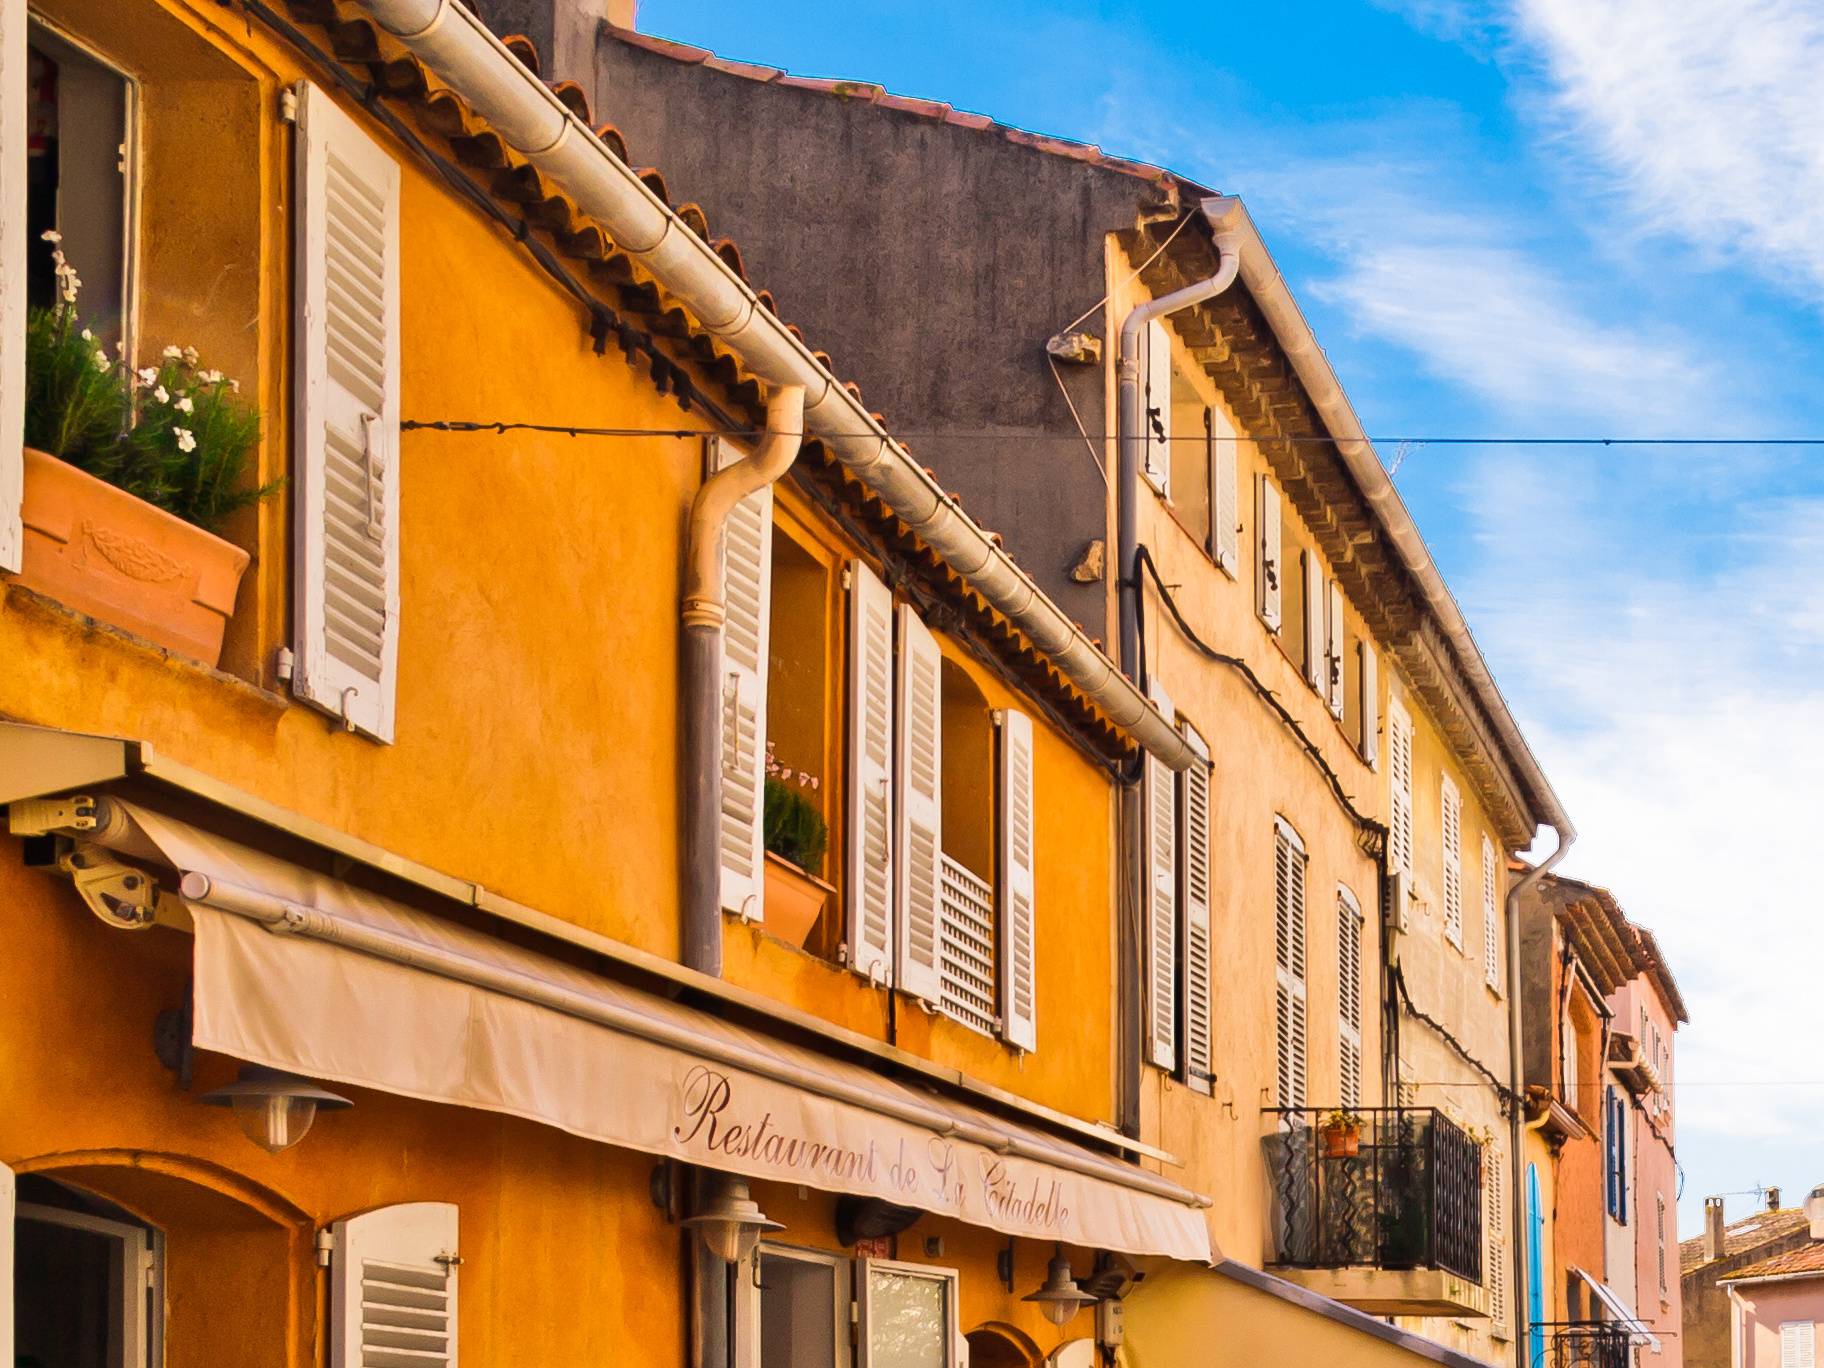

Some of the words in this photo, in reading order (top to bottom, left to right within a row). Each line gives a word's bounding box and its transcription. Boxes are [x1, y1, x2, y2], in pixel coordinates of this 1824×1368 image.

[674, 1065, 878, 1183] Restaurant
[889, 1137, 918, 1194] de
[927, 1137, 967, 1207] La
[979, 1151, 1070, 1229] Citadelle
